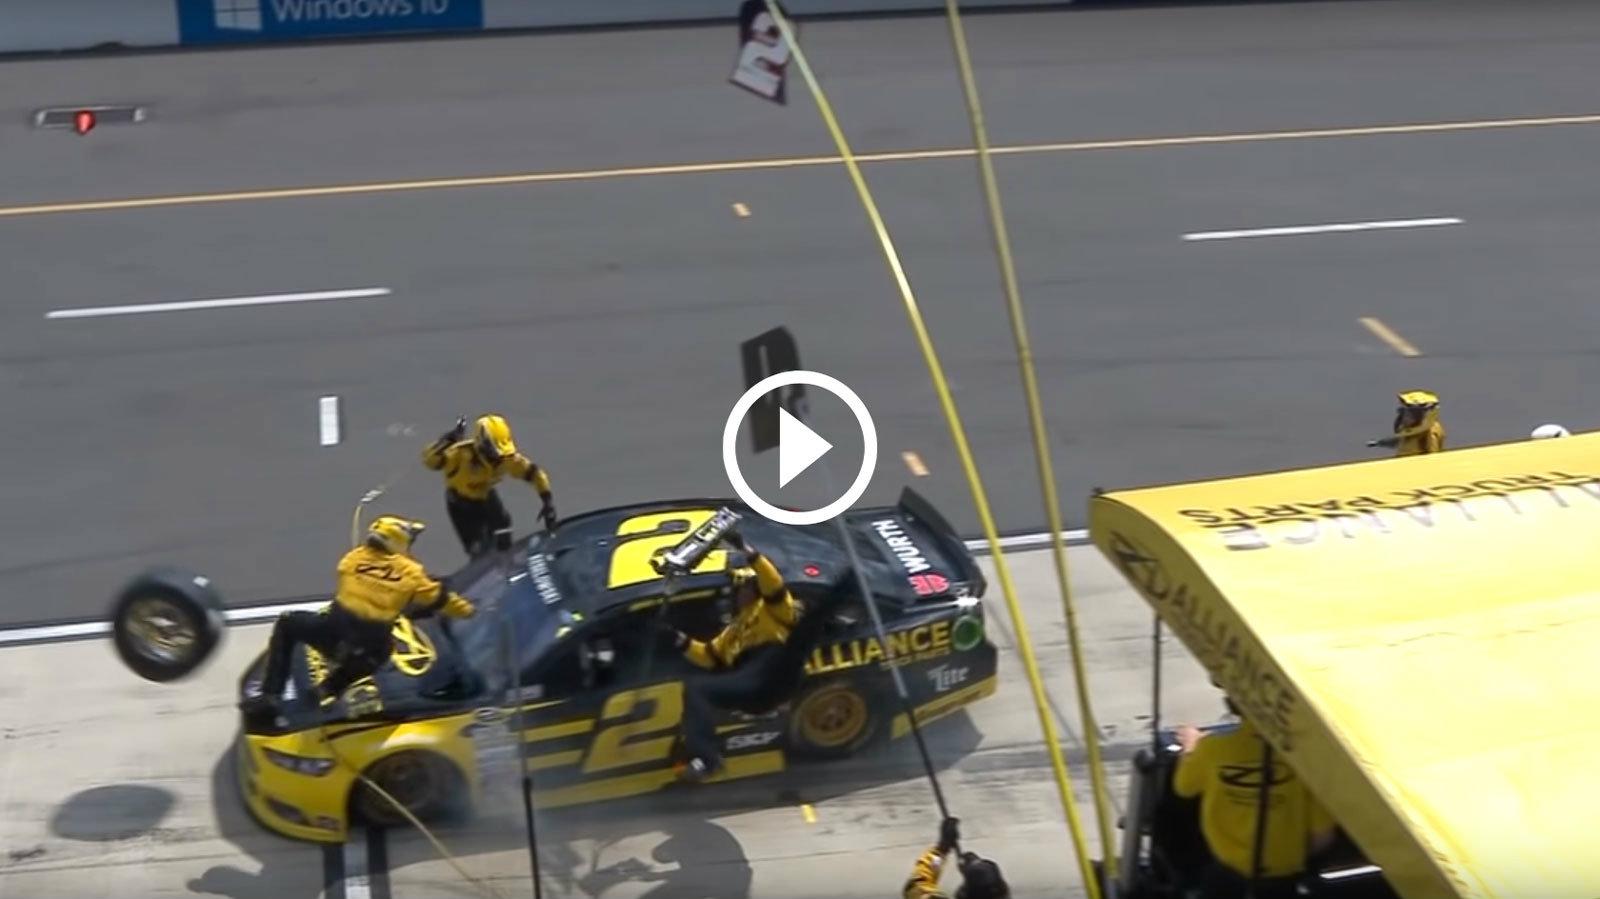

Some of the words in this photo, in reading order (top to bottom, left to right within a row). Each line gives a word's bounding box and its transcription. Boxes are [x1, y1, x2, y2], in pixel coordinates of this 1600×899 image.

[272, 0, 414, 21] Windows
[421, 0, 449, 14] 10
[732, 11, 790, 97] 2
[1178, 496, 1386, 523] PARTS
[1388, 471, 1590, 501] TRUCK
[607, 510, 728, 589] 2
[583, 681, 684, 773] 2
